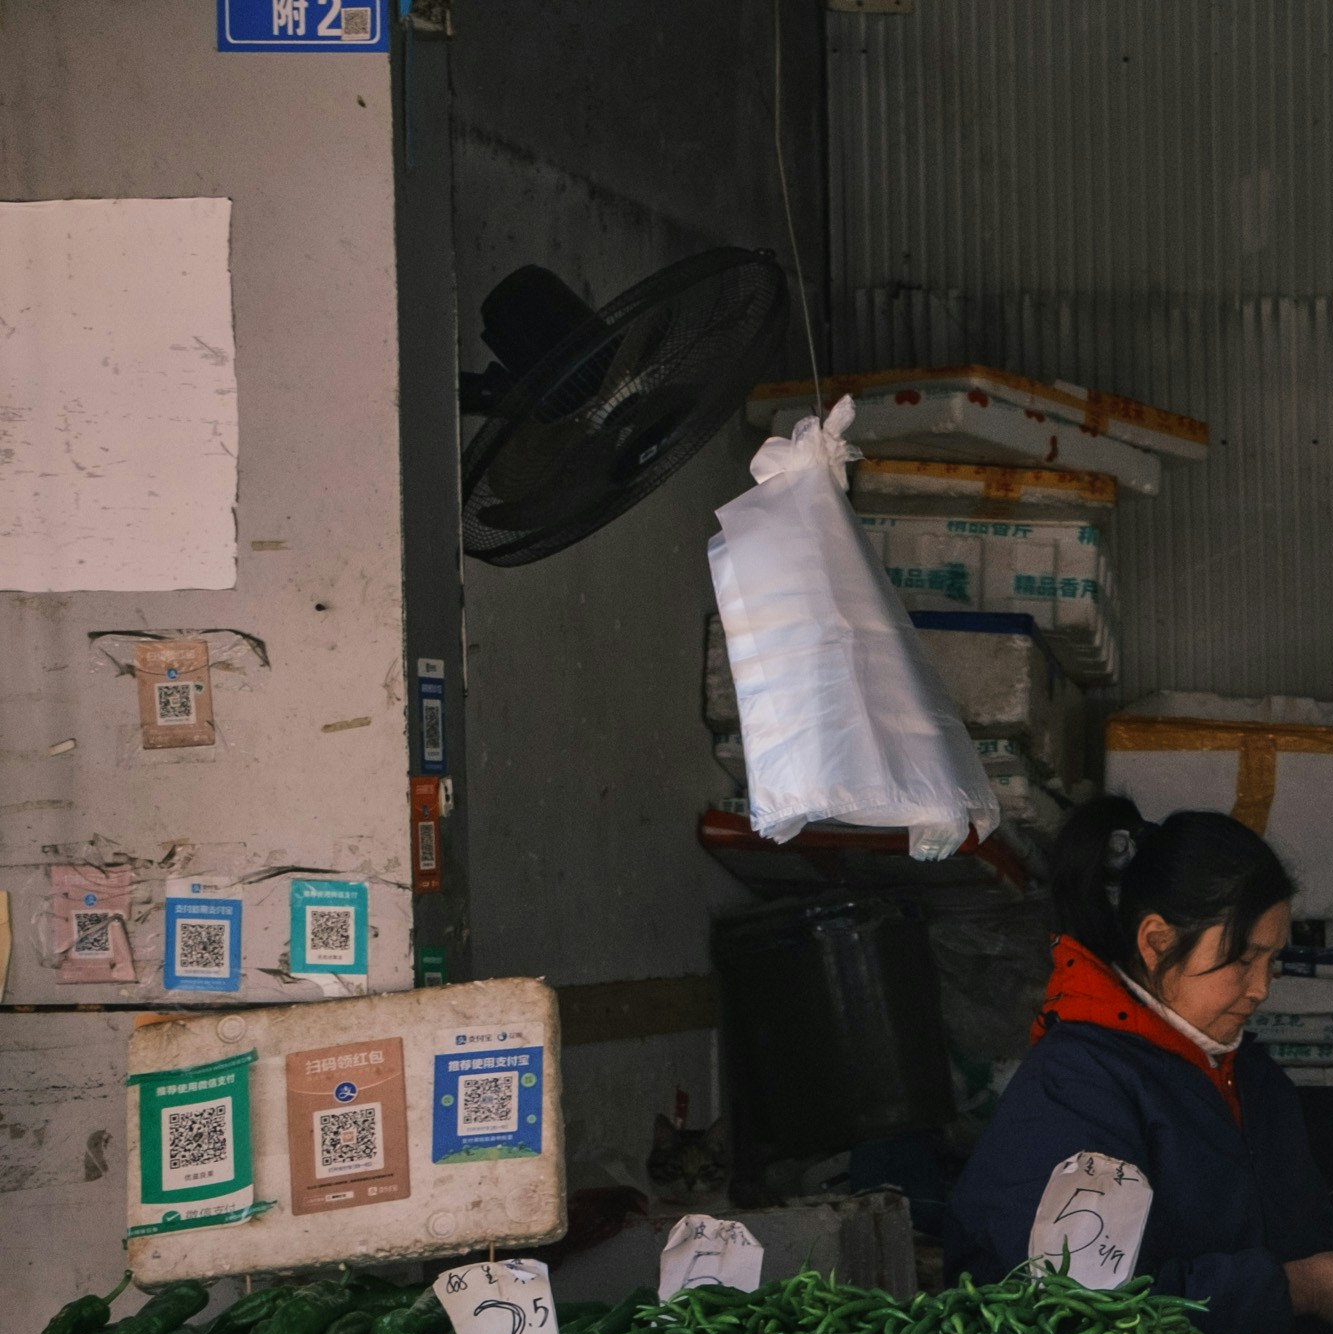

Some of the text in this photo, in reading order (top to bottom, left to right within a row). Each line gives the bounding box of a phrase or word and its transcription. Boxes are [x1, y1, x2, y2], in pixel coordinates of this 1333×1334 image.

[305, 1050, 386, 1076] 扫码领红包
[448, 1054, 530, 1073] 推荐使用支付宝
[1044, 1188, 1105, 1256] 5
